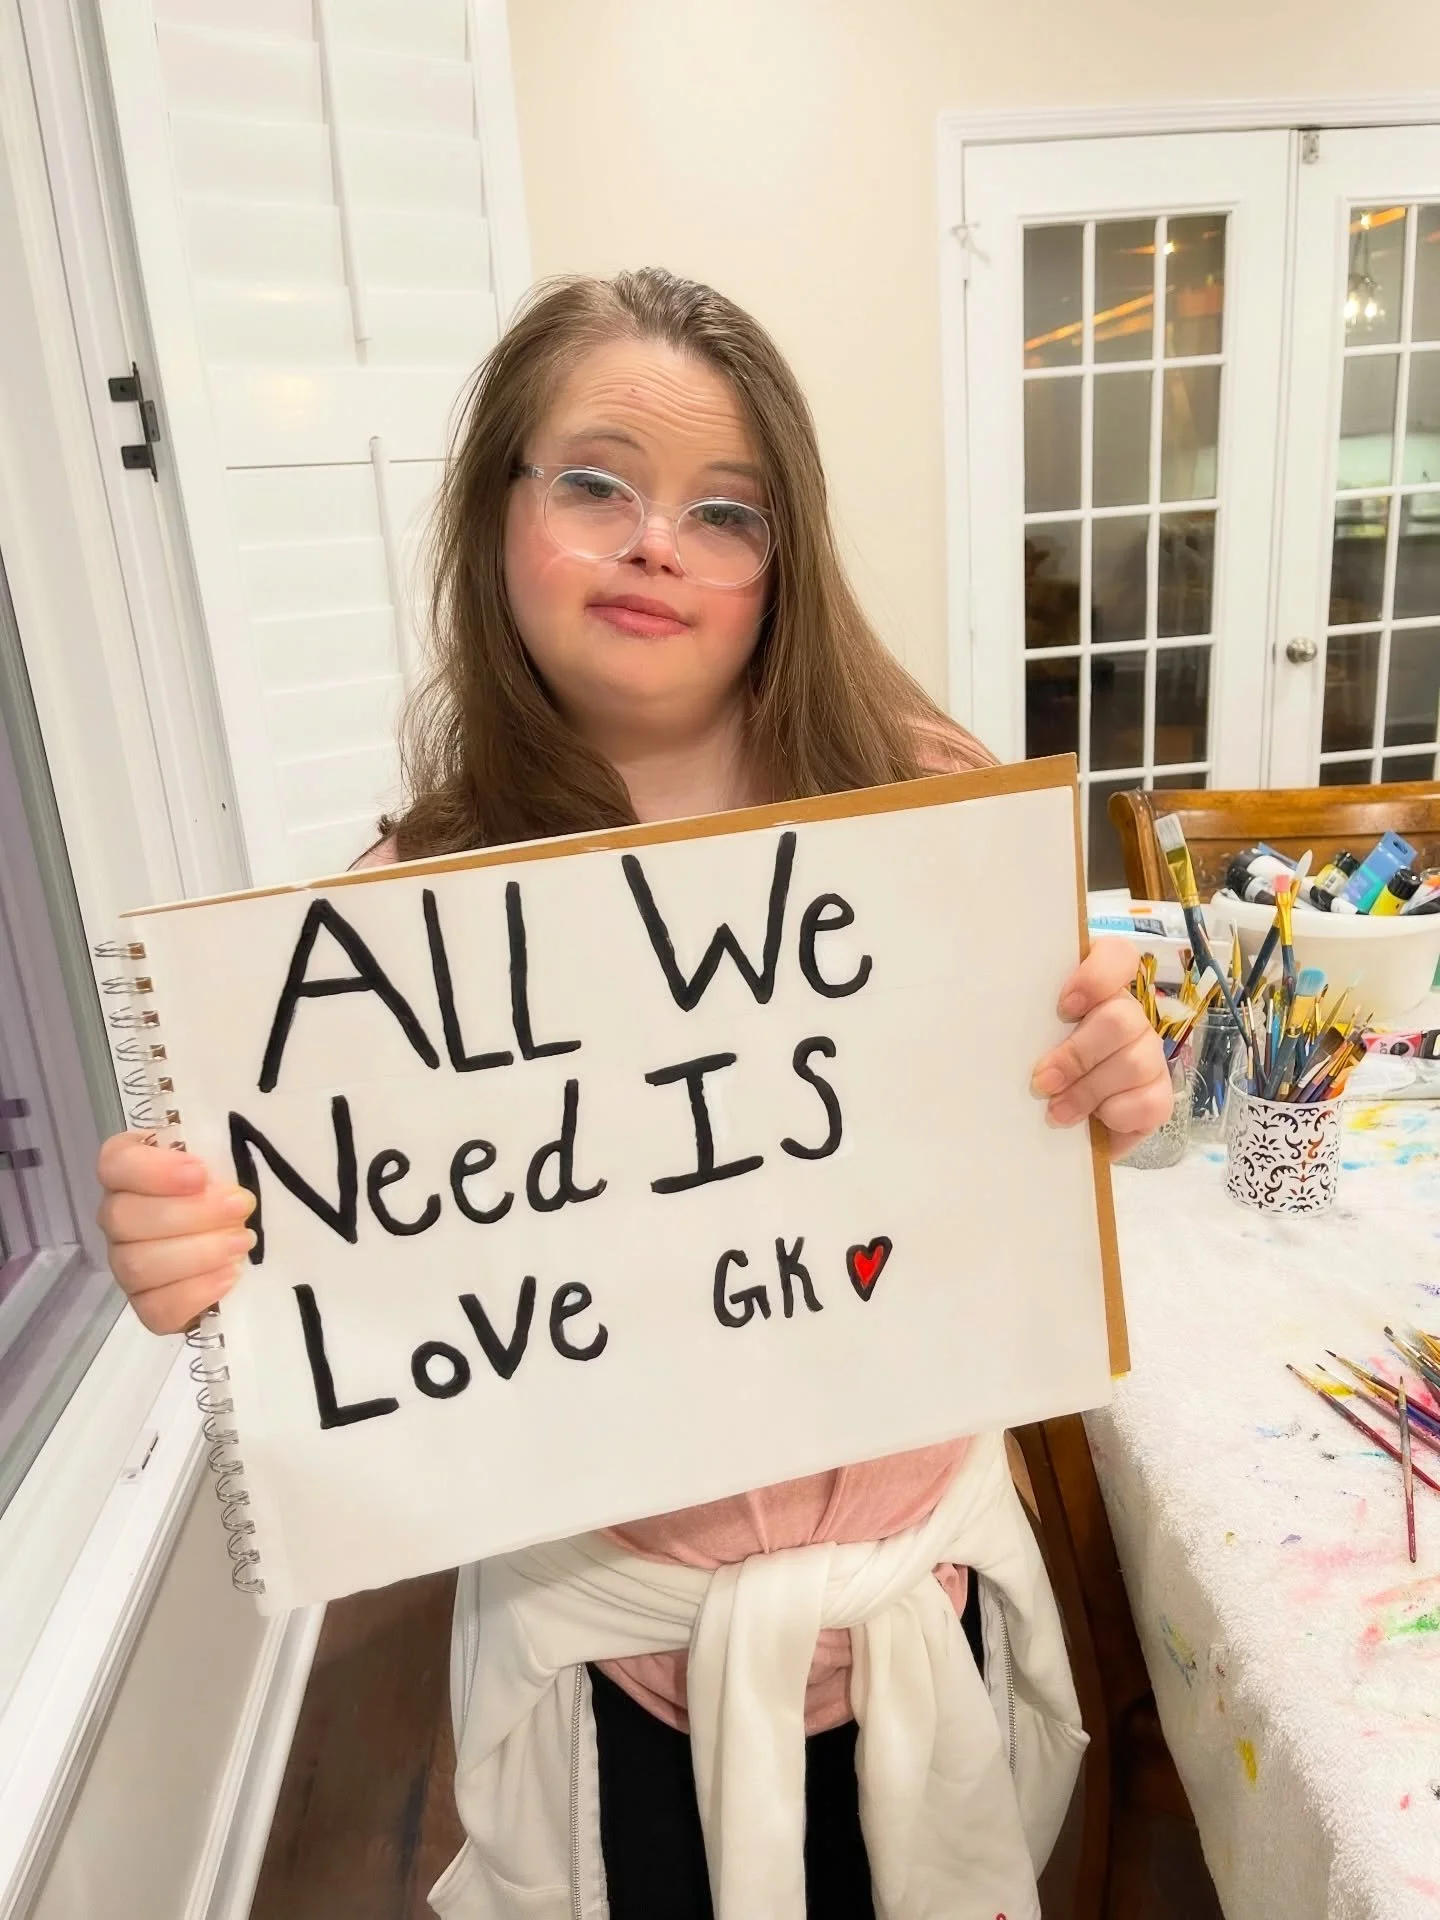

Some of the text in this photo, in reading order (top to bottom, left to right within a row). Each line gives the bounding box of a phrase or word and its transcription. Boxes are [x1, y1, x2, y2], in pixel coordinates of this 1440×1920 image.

[259, 832, 872, 1093] ALL We
[229, 1036, 843, 1265] Need IS
[713, 1237, 824, 1328] GK
